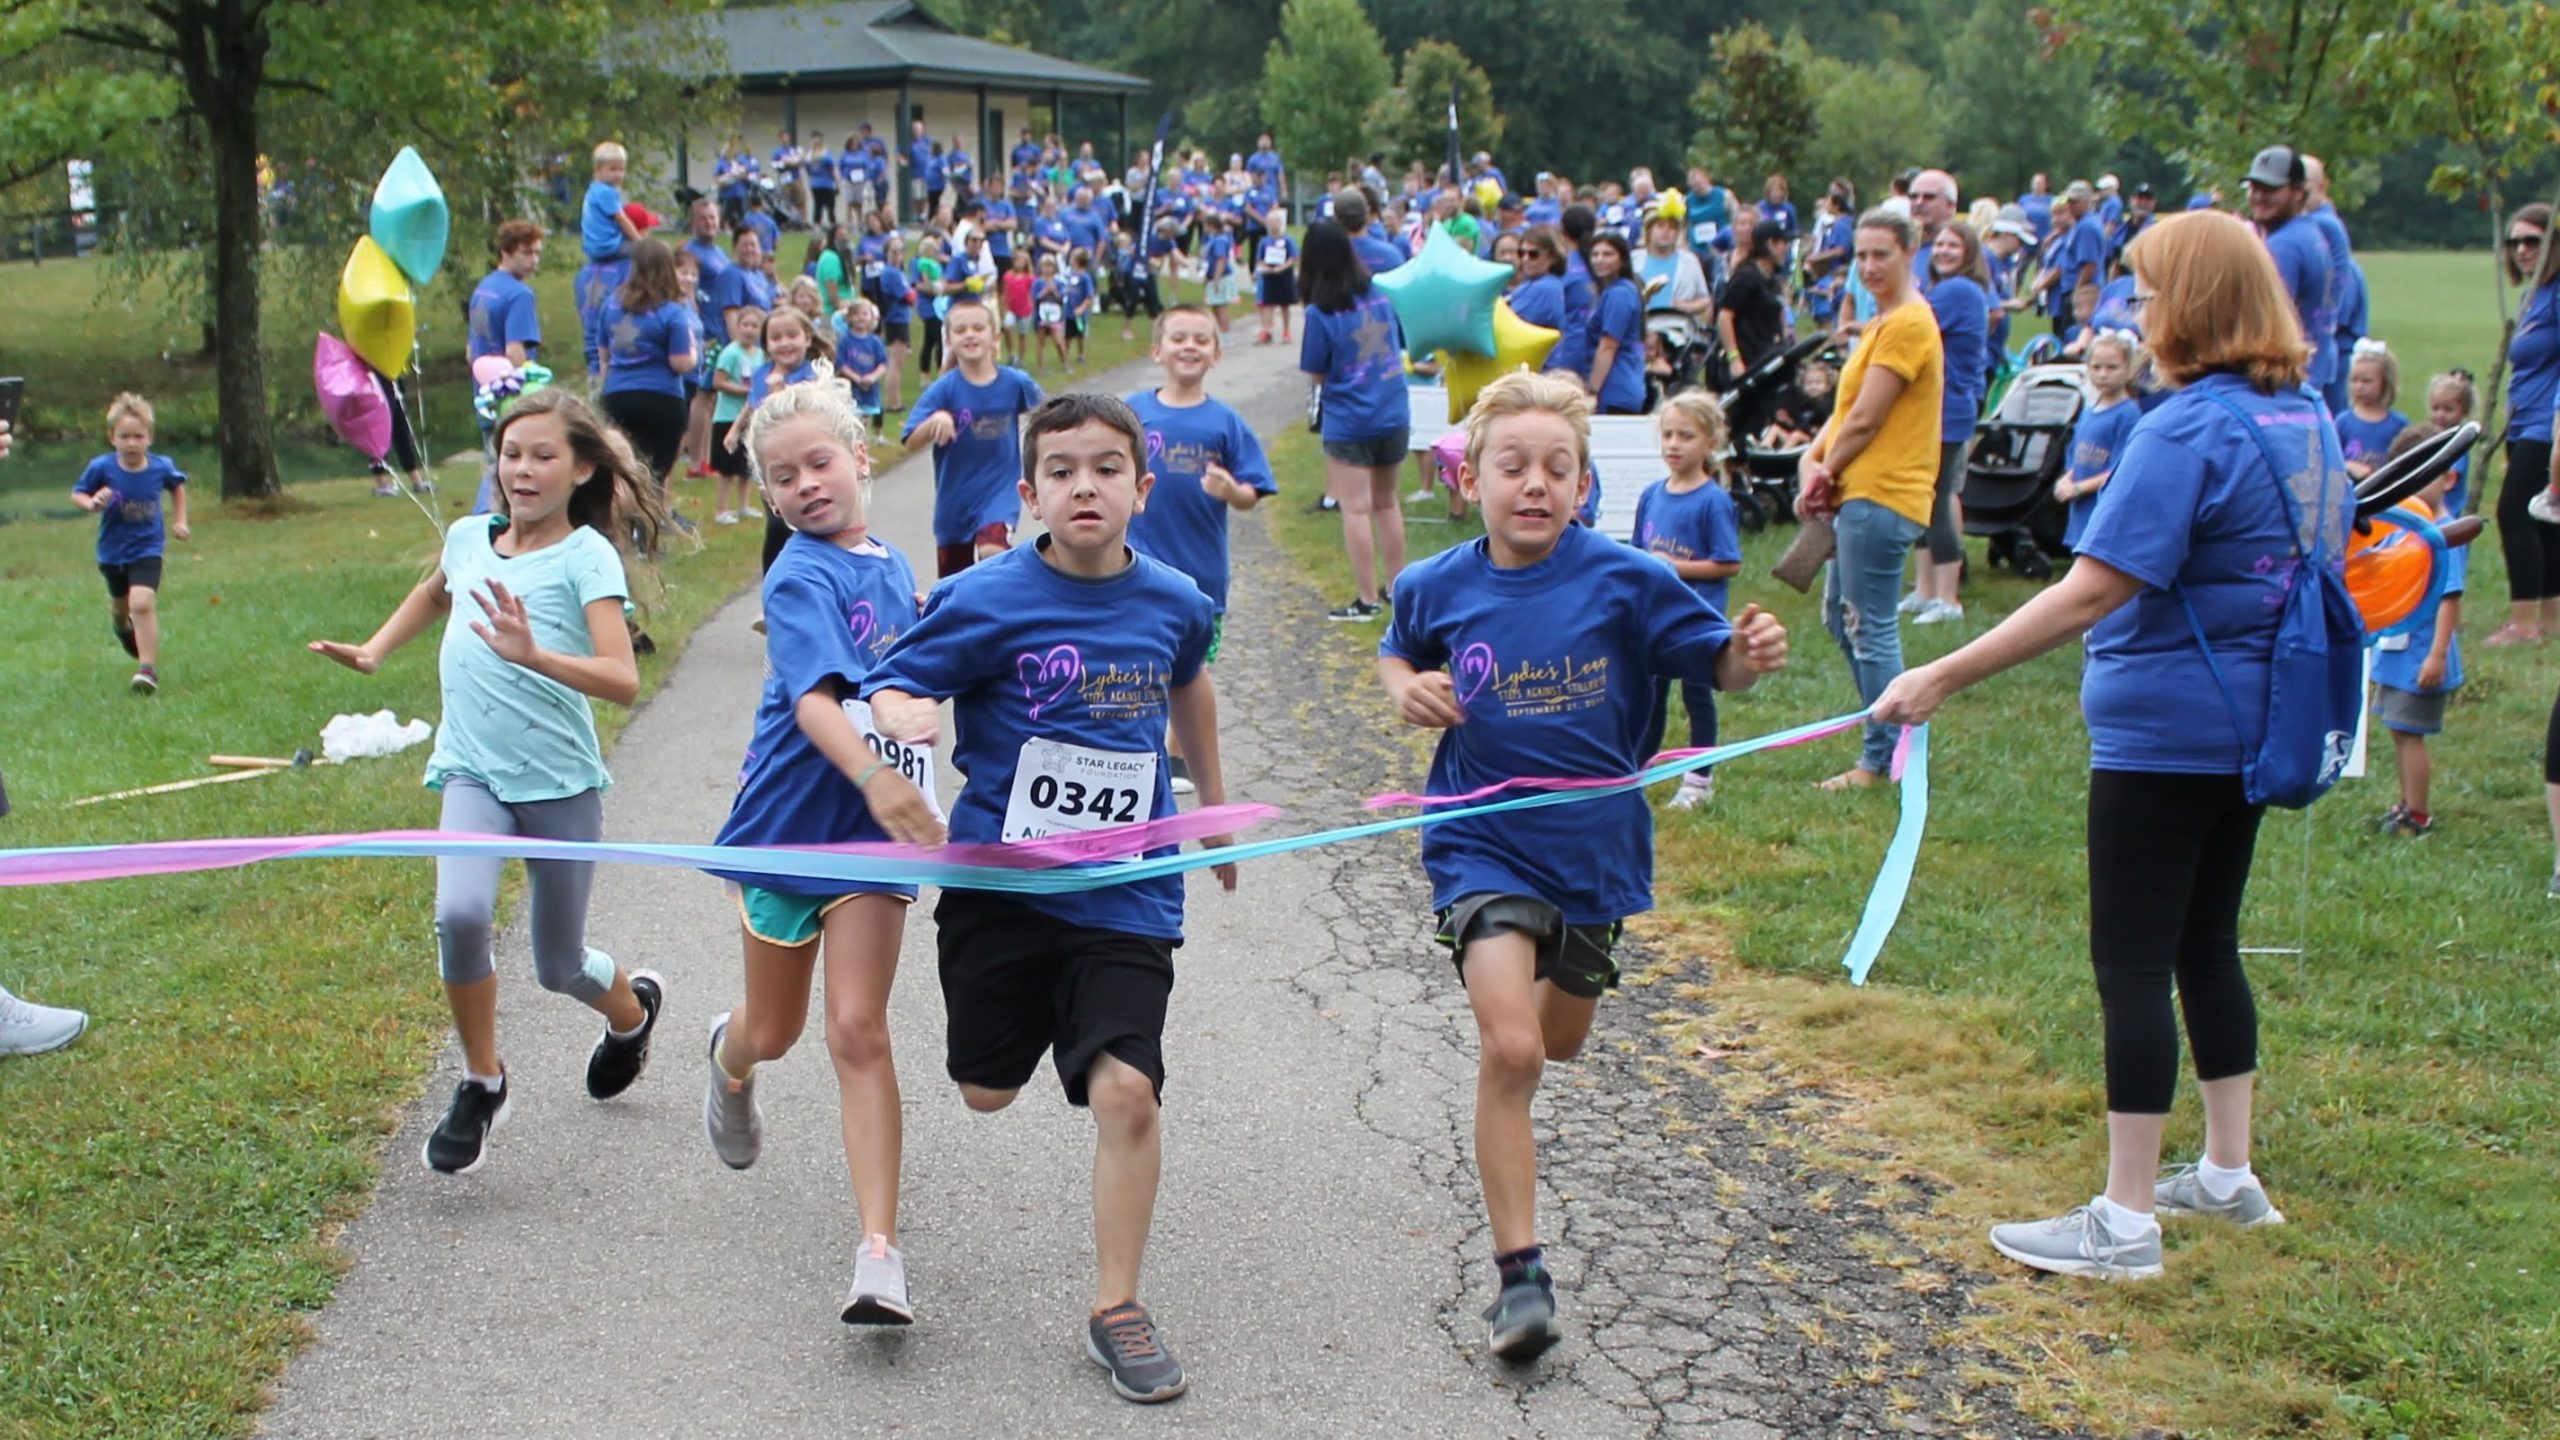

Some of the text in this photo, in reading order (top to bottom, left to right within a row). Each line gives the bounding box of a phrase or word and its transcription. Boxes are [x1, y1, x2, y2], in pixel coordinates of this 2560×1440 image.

[1077, 663, 1144, 693] Lydie's
[1491, 660, 1560, 692] Lydie's
[1527, 685, 1562, 698] AGAINST
[1506, 704, 1562, 718] SEPTEMBER
[1075, 756, 1145, 773] STAR LEGACY
[1080, 768, 1138, 780] FOUNDATION
[1029, 774, 1139, 823] 0342
